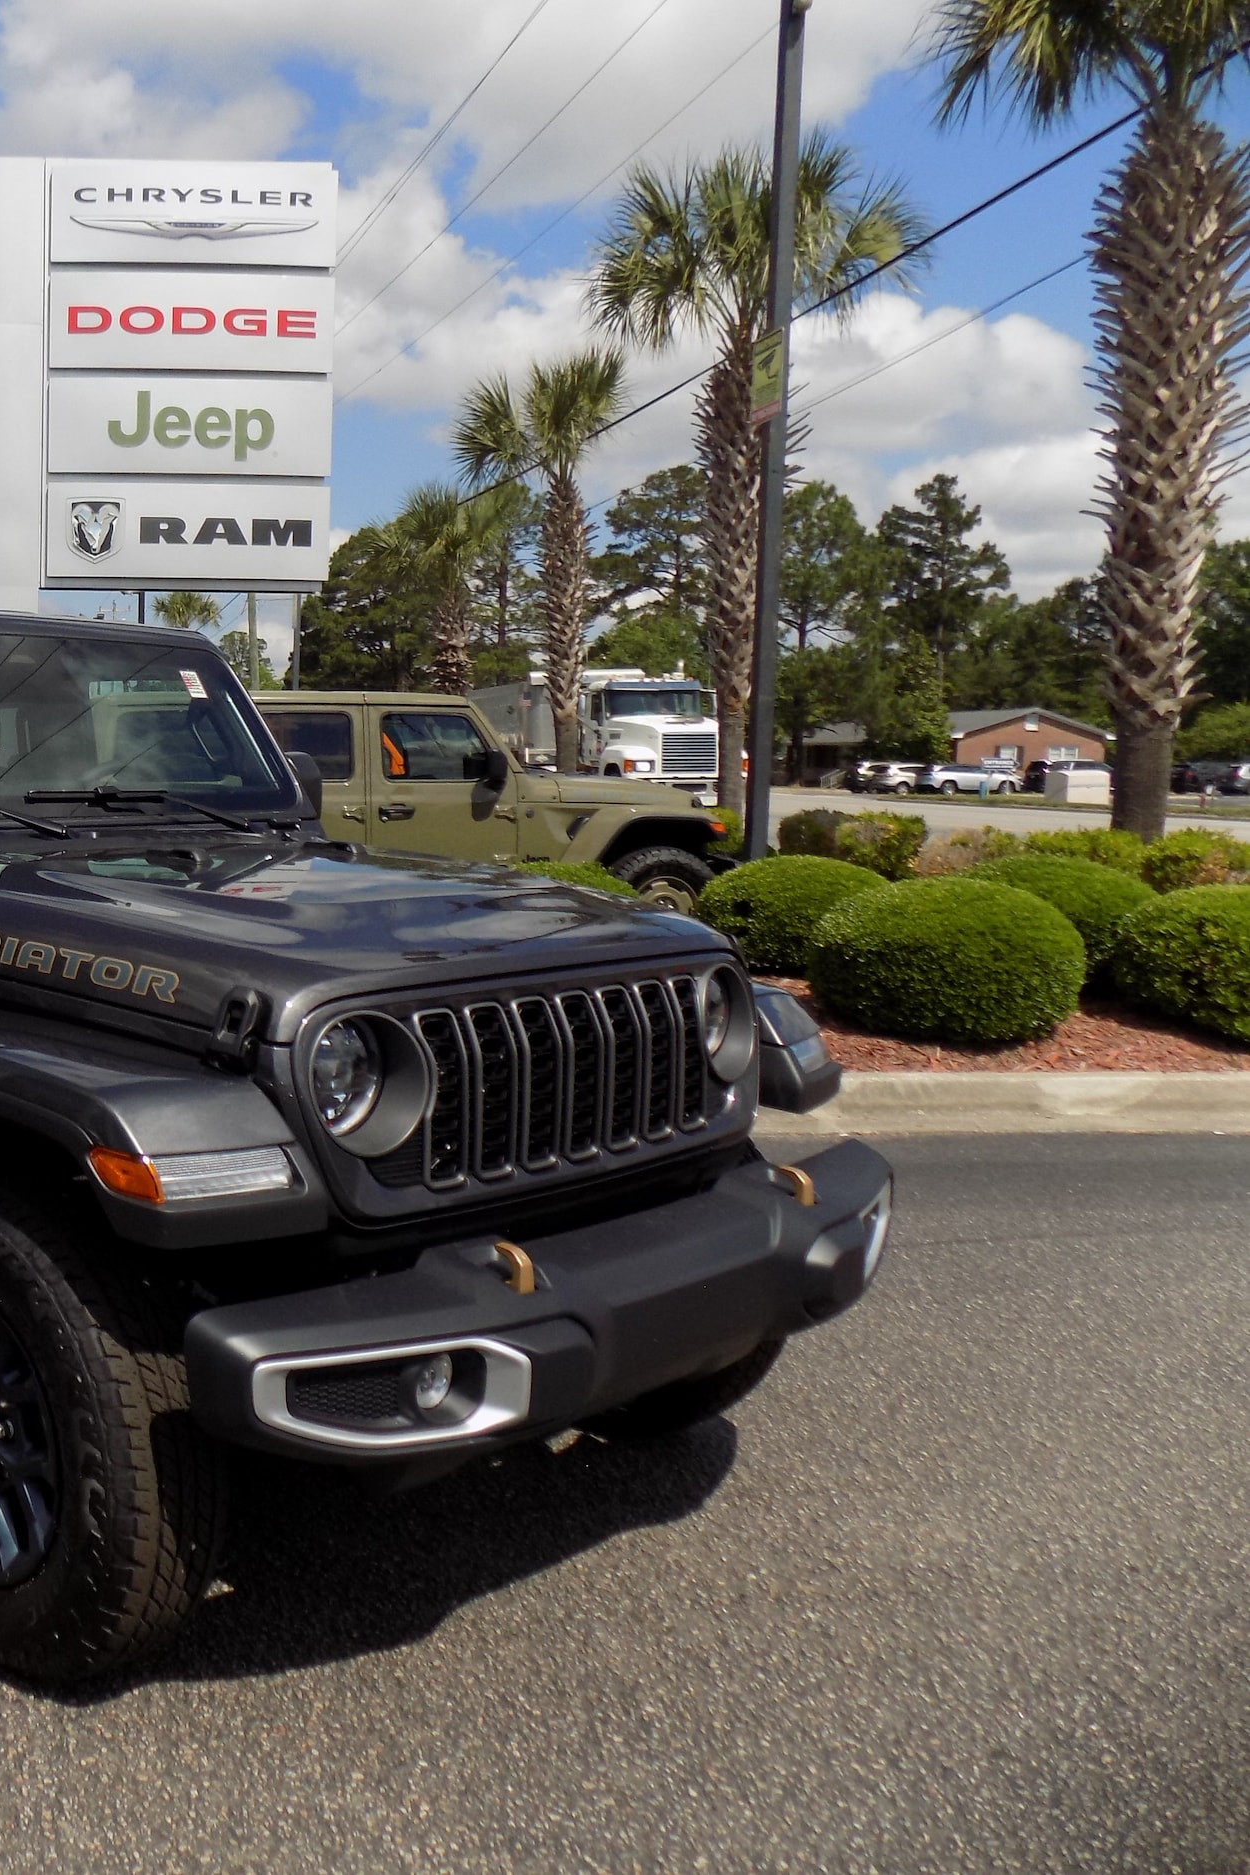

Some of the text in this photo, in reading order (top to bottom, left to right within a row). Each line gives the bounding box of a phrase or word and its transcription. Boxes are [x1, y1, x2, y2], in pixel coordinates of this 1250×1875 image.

[74, 187, 313, 207] CHRYSLER
[68, 306, 317, 339] DODGE
[107, 390, 275, 461] Jeep
[139, 516, 312, 547] RAM
